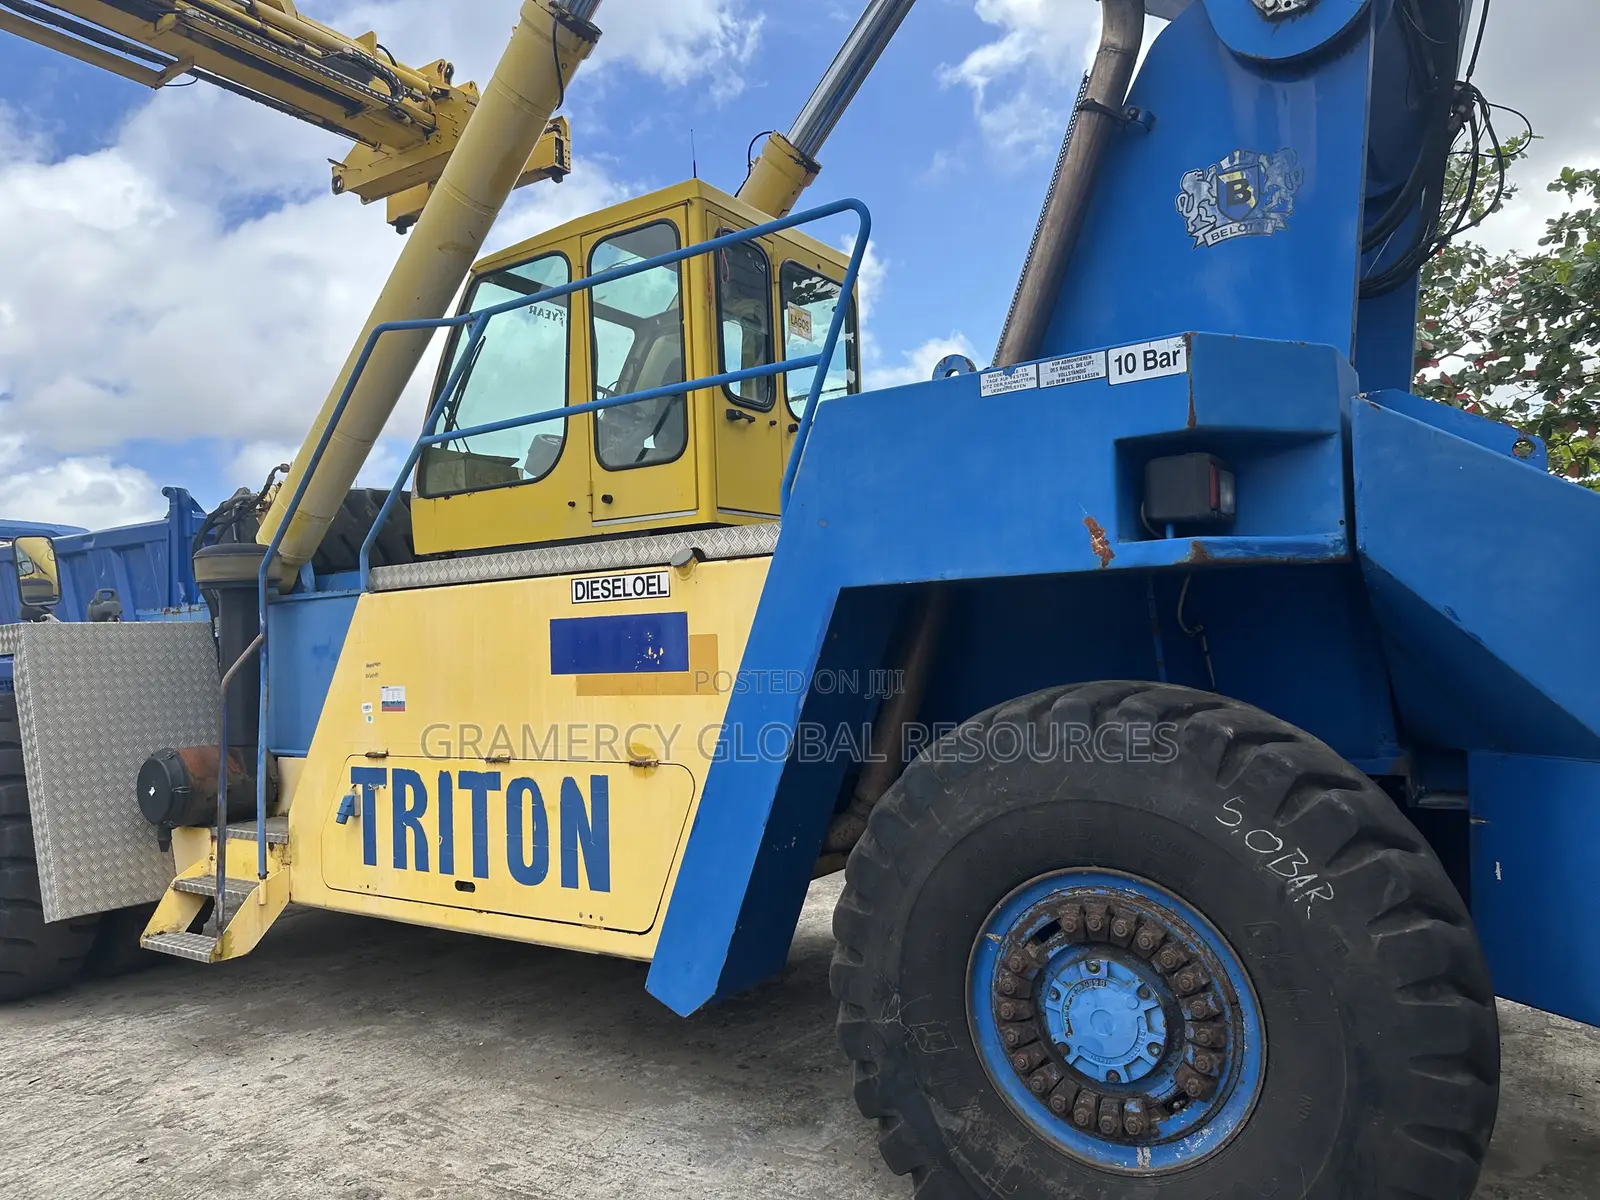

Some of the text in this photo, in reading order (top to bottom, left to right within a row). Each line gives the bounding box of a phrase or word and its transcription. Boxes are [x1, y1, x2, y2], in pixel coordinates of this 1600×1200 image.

[1226, 179, 1252, 207] B
[1114, 348, 1181, 376] 10 Bar
[574, 574, 668, 601] DIESELOEL
[350, 766, 611, 893] TRITON
